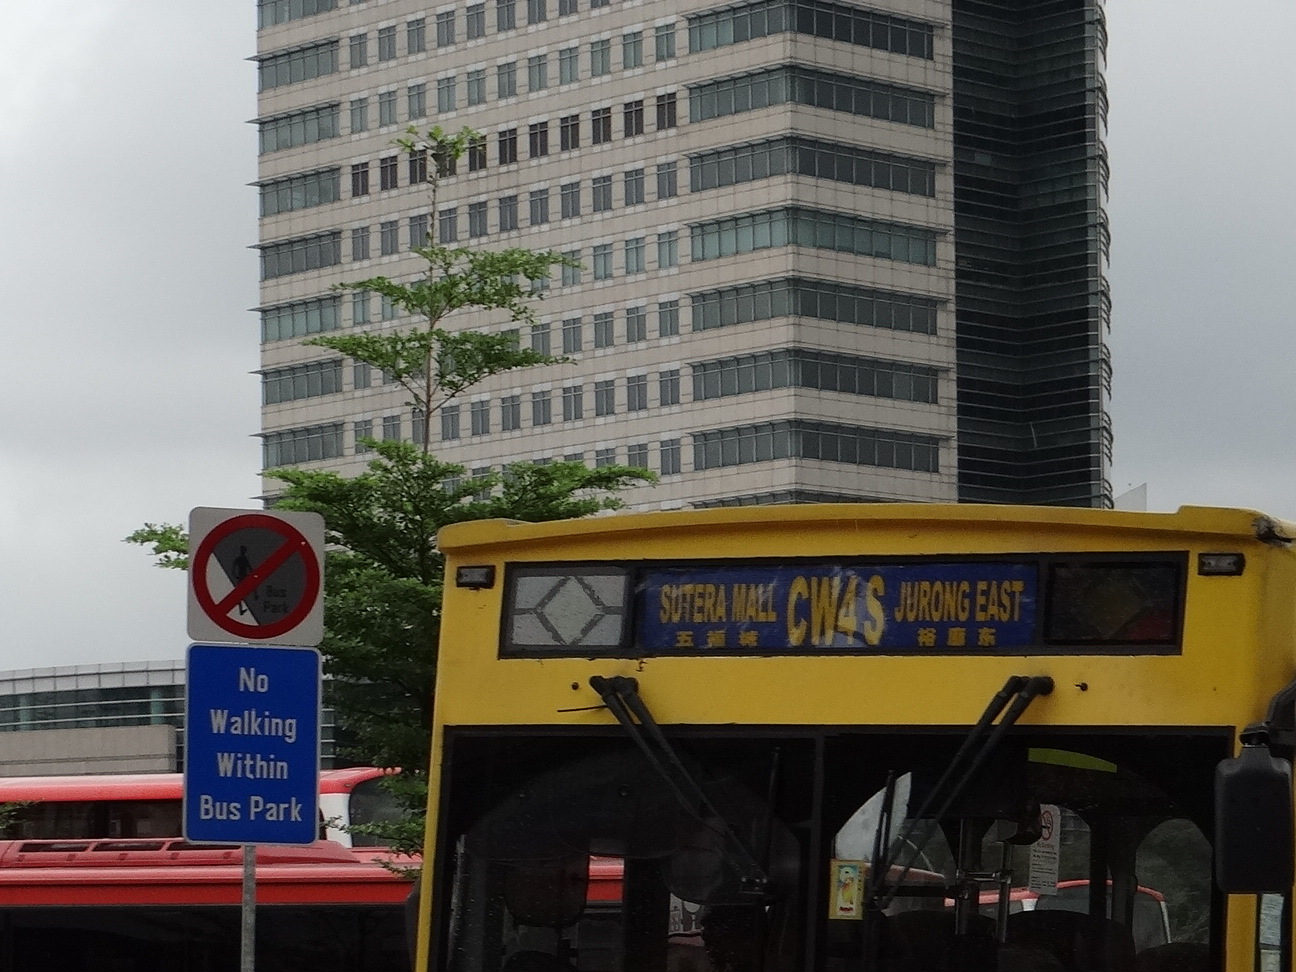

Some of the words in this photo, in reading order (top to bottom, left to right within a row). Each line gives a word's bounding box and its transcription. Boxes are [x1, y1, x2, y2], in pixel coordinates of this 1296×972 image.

[266, 584, 287, 597] Bus
[660, 583, 726, 623] SUTERA
[732, 583, 778, 622] MALL
[894, 580, 970, 622] JURONG
[975, 580, 1025, 622] EAST
[787, 575, 885, 647] CW4S
[238, 667, 269, 693] No
[210, 709, 297, 743] Walking
[217, 752, 289, 780] Within
[200, 794, 241, 820] Bus
[250, 796, 302, 822] Park
